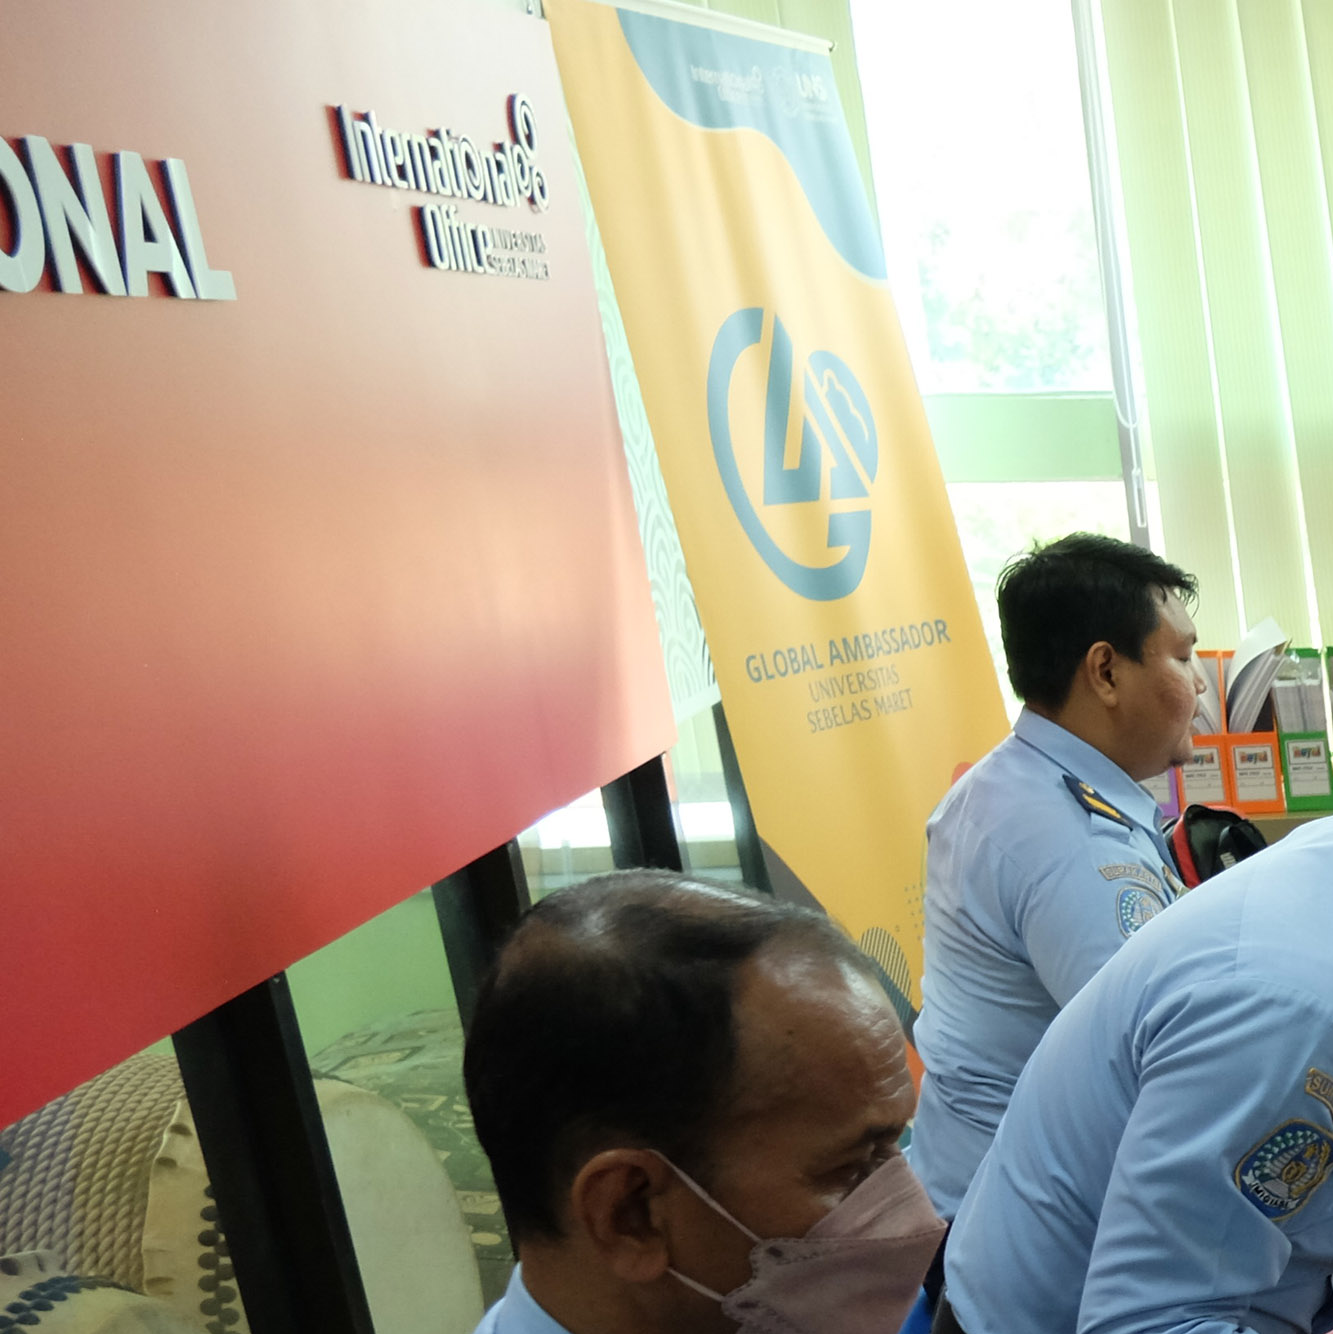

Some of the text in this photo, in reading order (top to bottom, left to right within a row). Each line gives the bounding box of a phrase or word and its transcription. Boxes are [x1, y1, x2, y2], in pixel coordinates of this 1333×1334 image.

[325, 103, 522, 208] International
[414, 203, 495, 274] Office
[745, 619, 951, 683] GLOBAL AMBASSADOR
[806, 688, 914, 734] SEBELAS MARET
[808, 664, 900, 703] UNIVERSITAS
